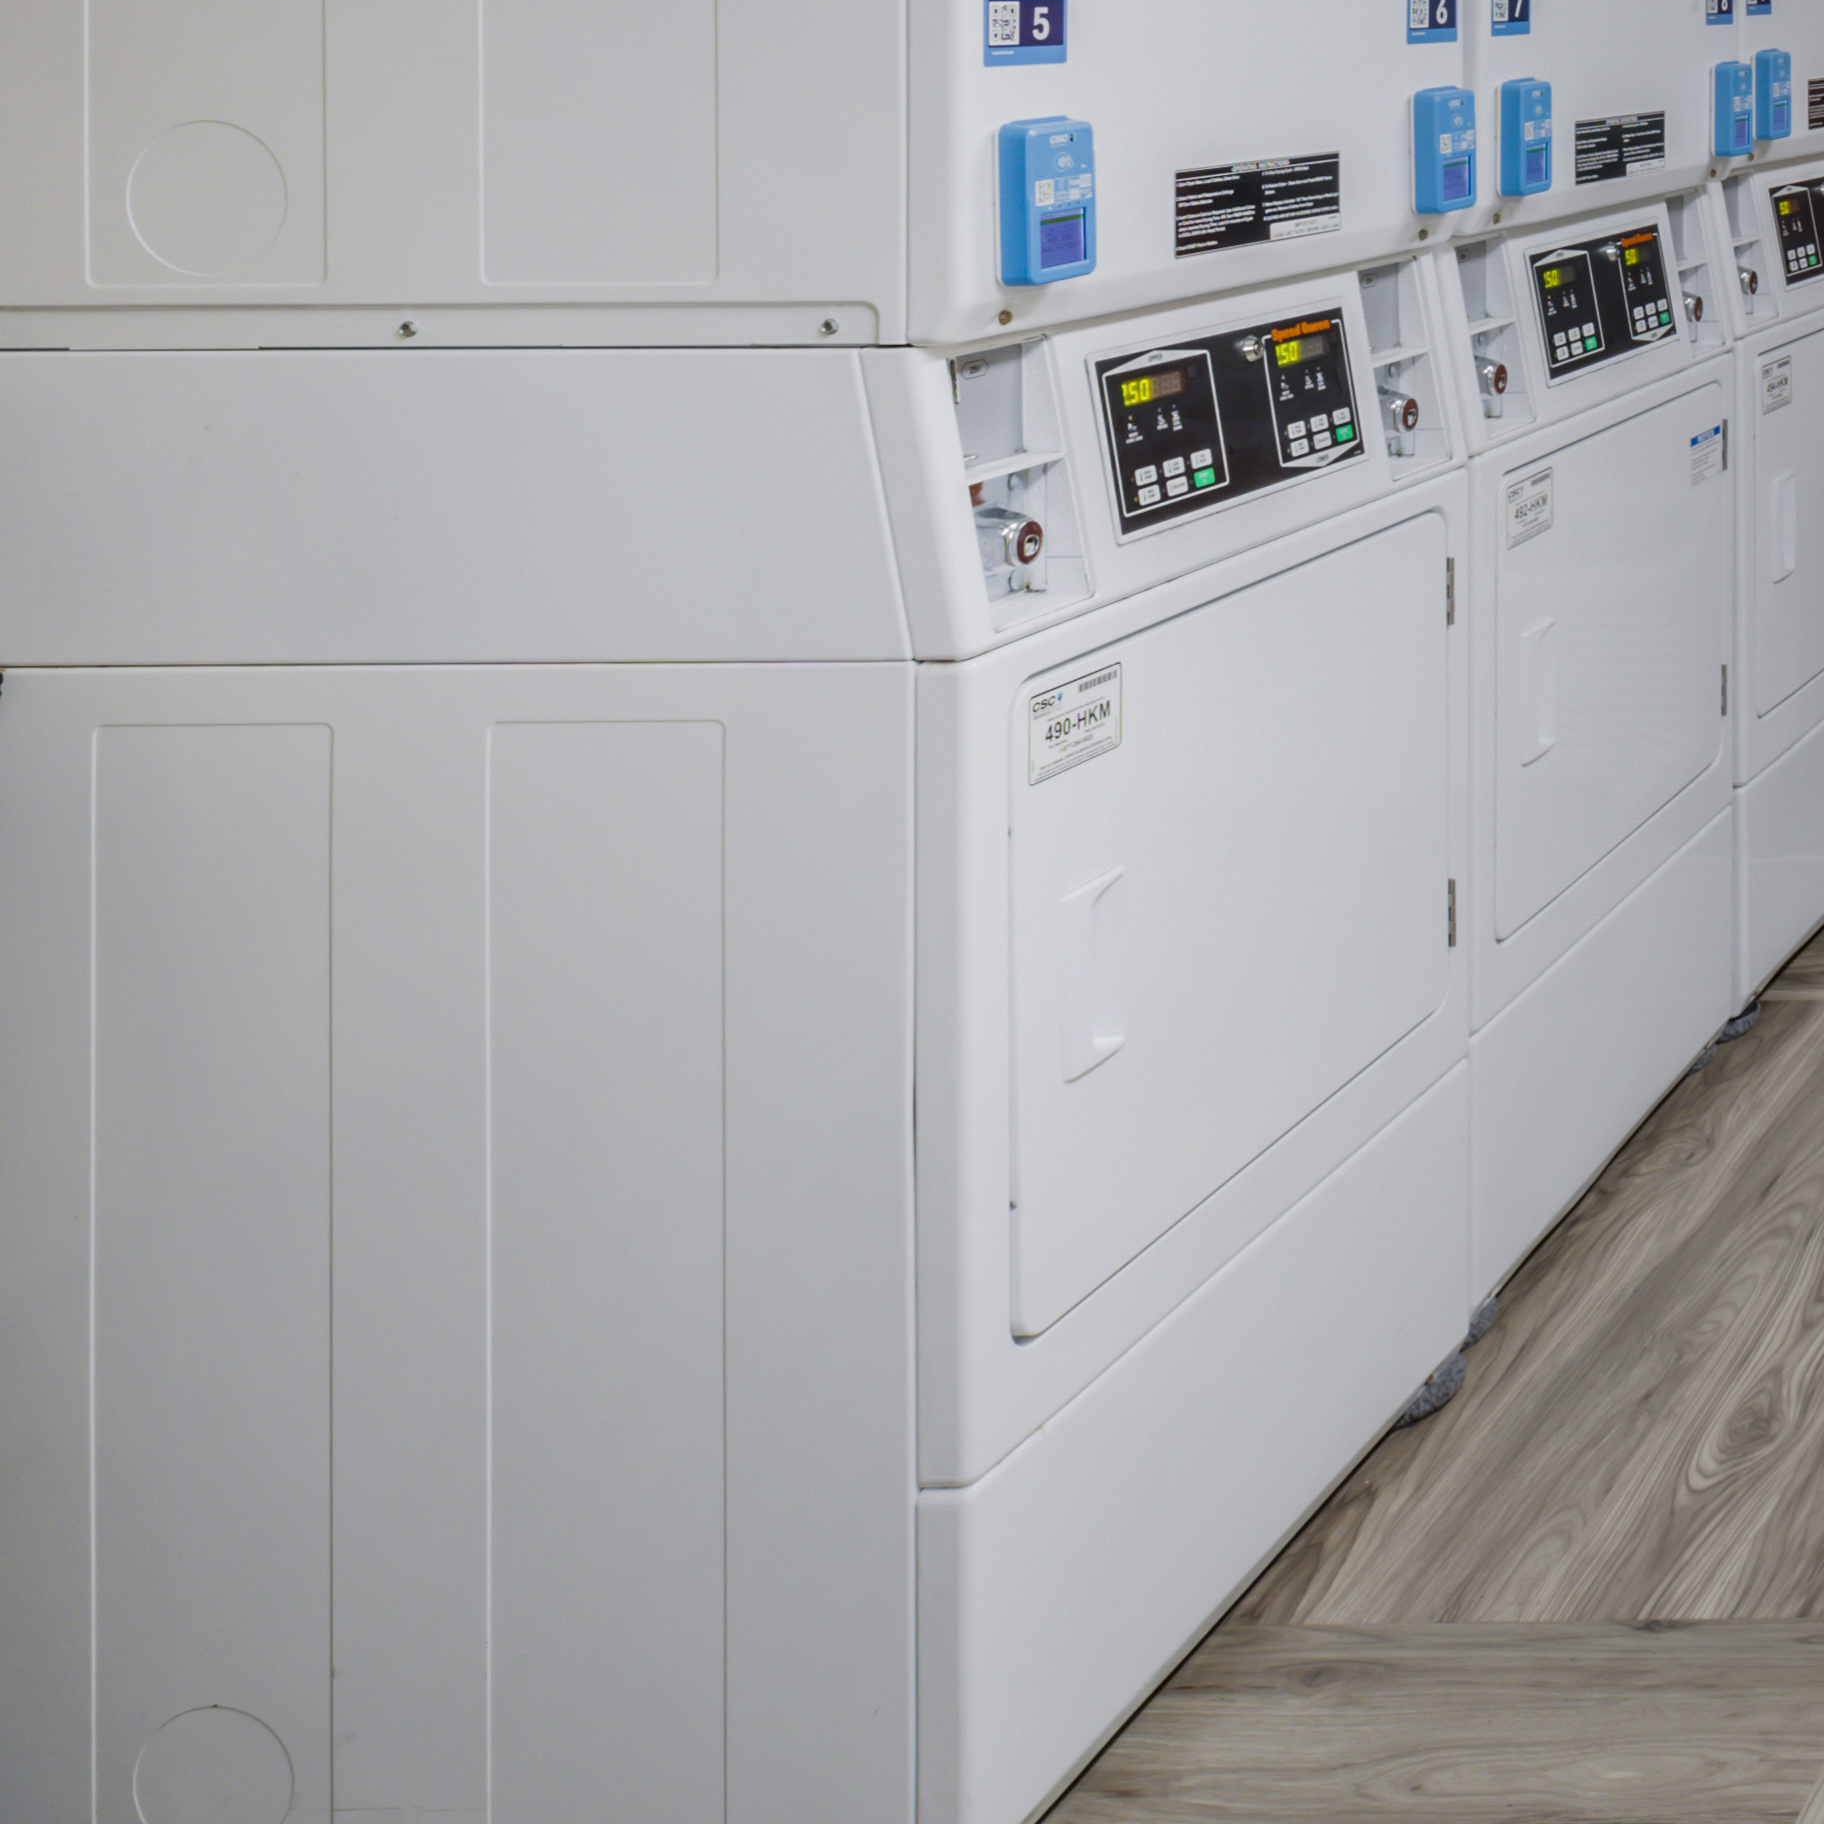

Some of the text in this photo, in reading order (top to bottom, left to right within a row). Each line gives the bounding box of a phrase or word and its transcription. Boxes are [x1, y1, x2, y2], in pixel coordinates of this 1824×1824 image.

[1032, 6, 1050, 40] 5
[1271, 319, 1331, 343] Speed Queen
[1032, 696, 1056, 713] CSC
[1045, 700, 1111, 742] 490-HKM
